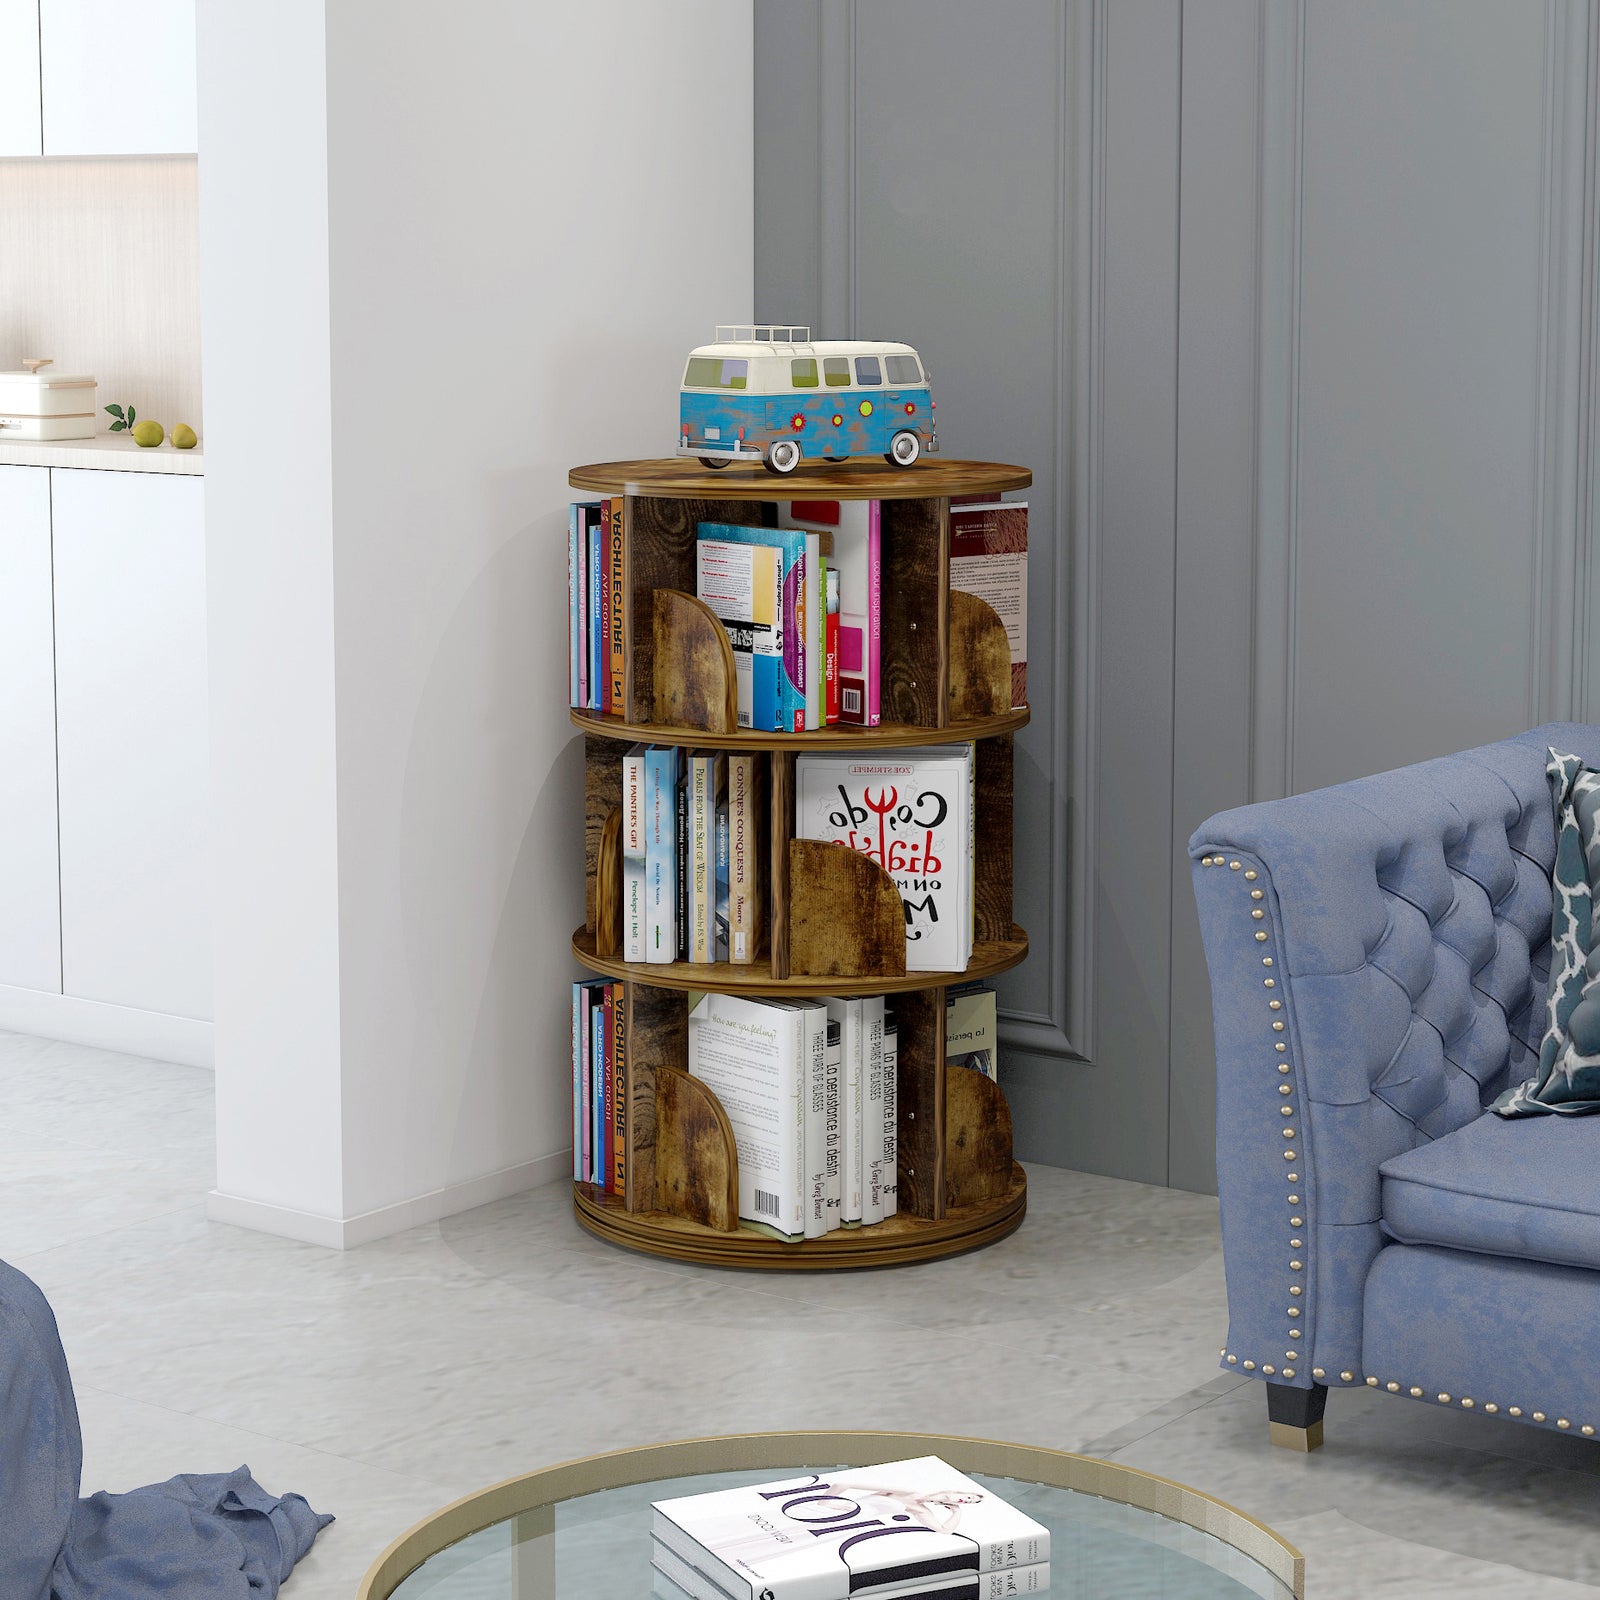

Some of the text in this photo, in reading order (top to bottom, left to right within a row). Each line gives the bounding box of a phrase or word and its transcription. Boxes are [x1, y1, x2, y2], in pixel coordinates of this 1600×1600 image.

[696, 852, 703, 860] OF
[812, 1030, 824, 1112] THREE PAIRS OF GLASSES
[870, 1020, 881, 1100] THREE PAIRS OF GLASSES
[827, 1078, 840, 1131] persistance
[884, 1066, 897, 1118] persistance
[827, 1134, 840, 1146] du
[884, 1120, 897, 1134] du
[884, 1136, 897, 1164] destin
[827, 1148, 840, 1178] destin
[869, 1160, 882, 1206] by Greg Bennet
[812, 1172, 824, 1220] by Greg Bennet
